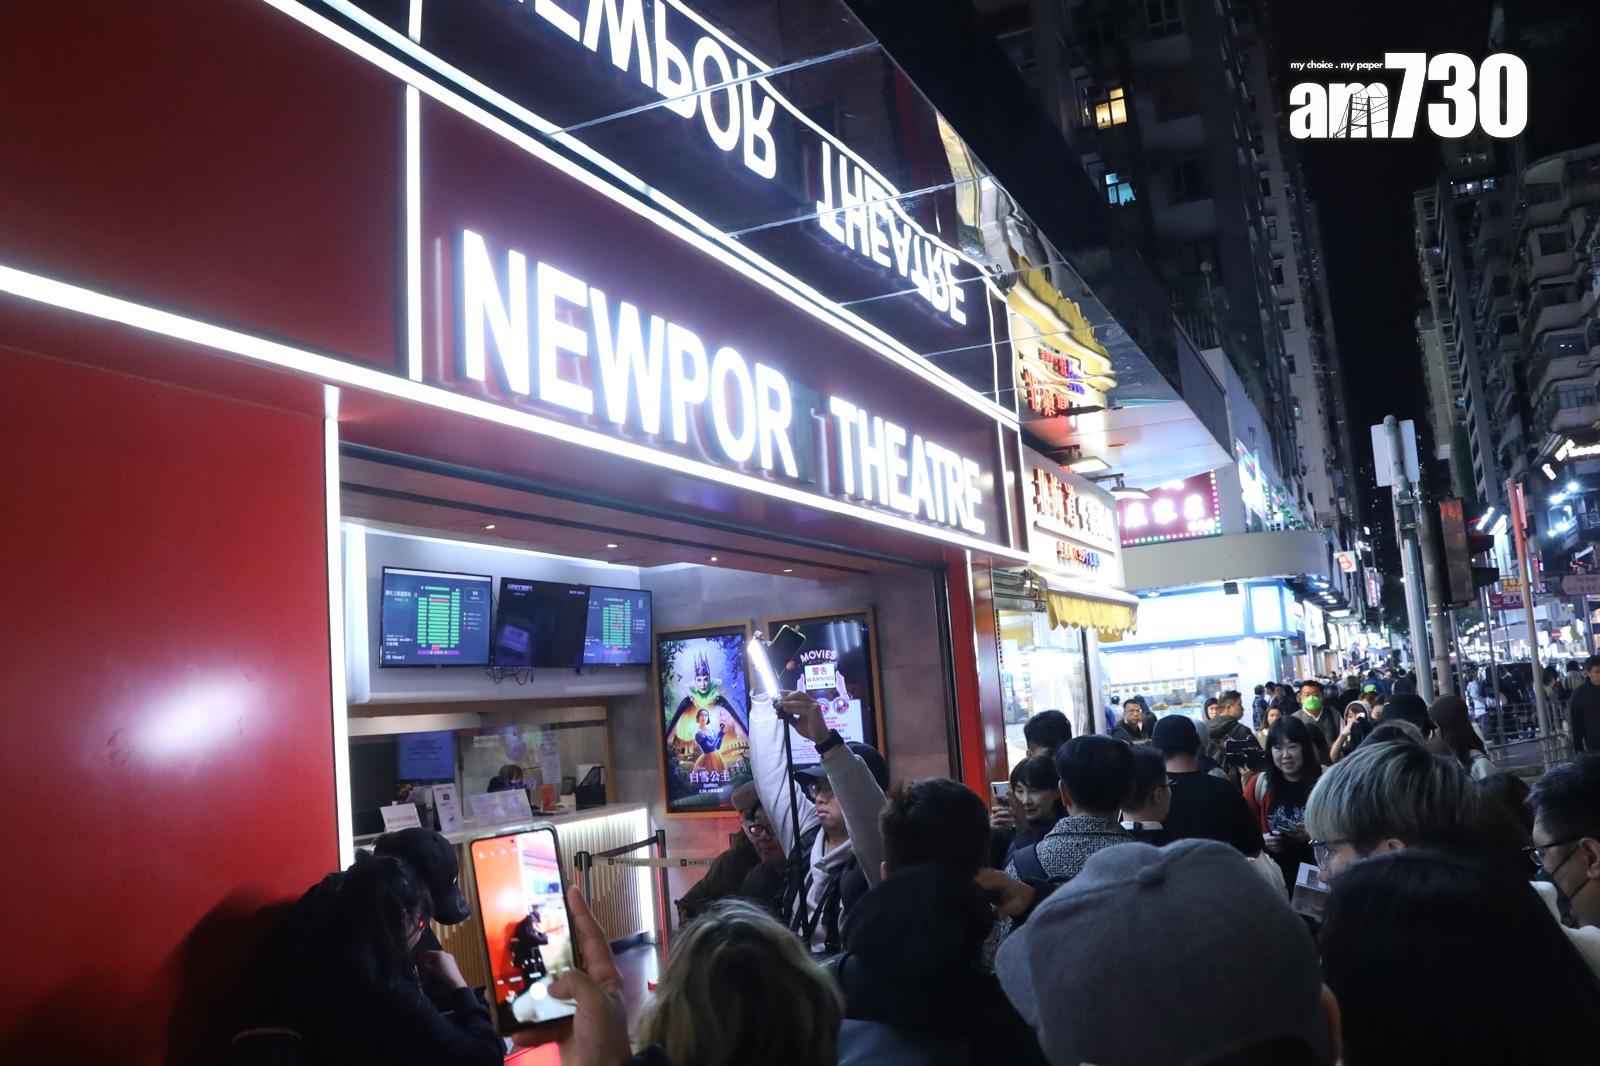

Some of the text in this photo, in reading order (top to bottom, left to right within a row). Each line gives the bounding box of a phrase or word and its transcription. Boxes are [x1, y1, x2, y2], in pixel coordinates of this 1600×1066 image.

[829, 396, 986, 535] THEATRE
[800, 650, 837, 663] MOVIES
[689, 770, 731, 783] 白雪公主
